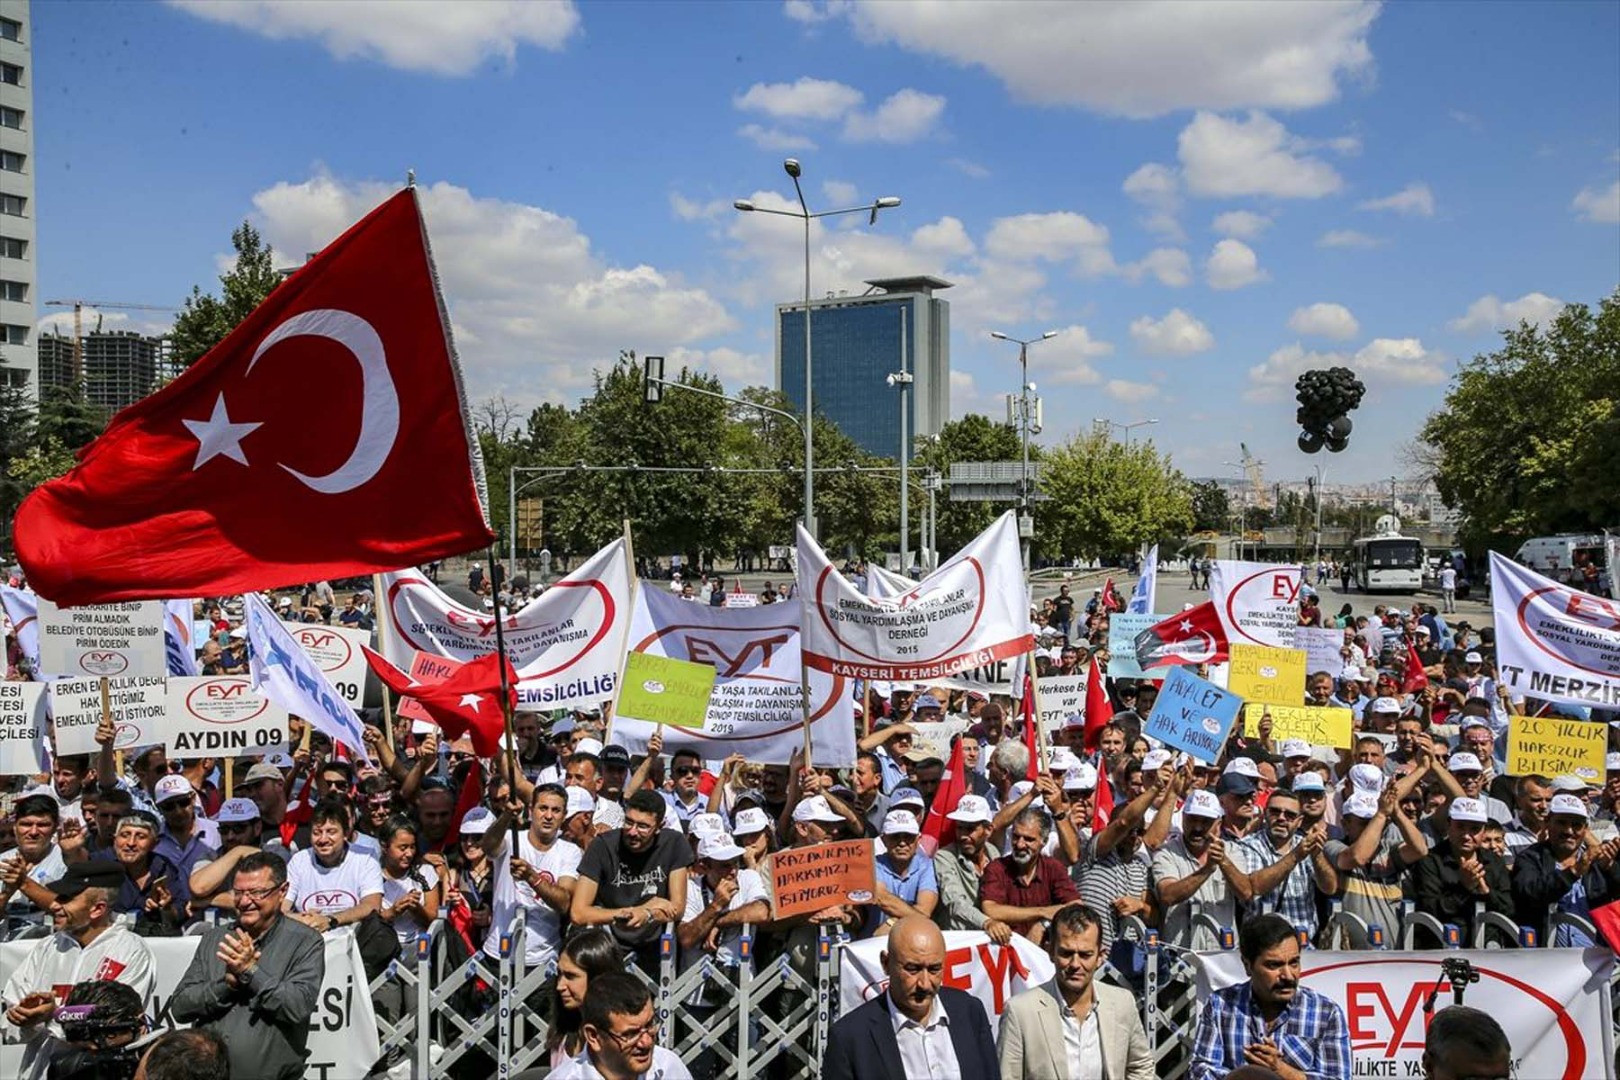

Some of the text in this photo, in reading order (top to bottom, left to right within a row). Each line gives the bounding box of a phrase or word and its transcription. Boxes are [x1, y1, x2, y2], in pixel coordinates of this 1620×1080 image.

[73, 614, 131, 623] PRİM ALMADIK
[829, 609, 861, 624] SOSYAL
[861, 612, 926, 628] YARDIMLAŞMA
[926, 610, 940, 622] VE
[46, 625, 85, 635] BELEDİYE
[86, 625, 136, 636] OTOBÜSÜNE
[888, 625, 928, 640] DERNEĞİ
[1536, 629, 1571, 644] SOSYAL
[301, 632, 335, 648] EYT
[684, 633, 789, 677] EYT
[896, 645, 919, 655] 2015
[831, 648, 995, 680] KAYSERİ TEMSİLCİLİĞİ
[56, 682, 89, 696] ERKEN
[207, 683, 248, 699] EYT
[721, 685, 745, 697] YAŞA
[1038, 683, 1076, 695] Herkese
[1168, 675, 1223, 709] ADALET
[80, 696, 101, 709] HAK
[1062, 698, 1078, 706] var
[707, 709, 792, 722] SİNOP TEMSİLCİLİĞİ
[1180, 706, 1200, 723] VE
[710, 723, 734, 734] 2019
[1154, 714, 1178, 736] HAK
[1519, 719, 1605, 742] 20 YILLIK
[174, 728, 283, 750] AYDIN 09
[1518, 741, 1589, 759] HAKSIZLIK
[316, 894, 342, 906] EYT
[1346, 982, 1452, 1059] EYT
[1352, 1057, 1397, 1077] İLİKTE
